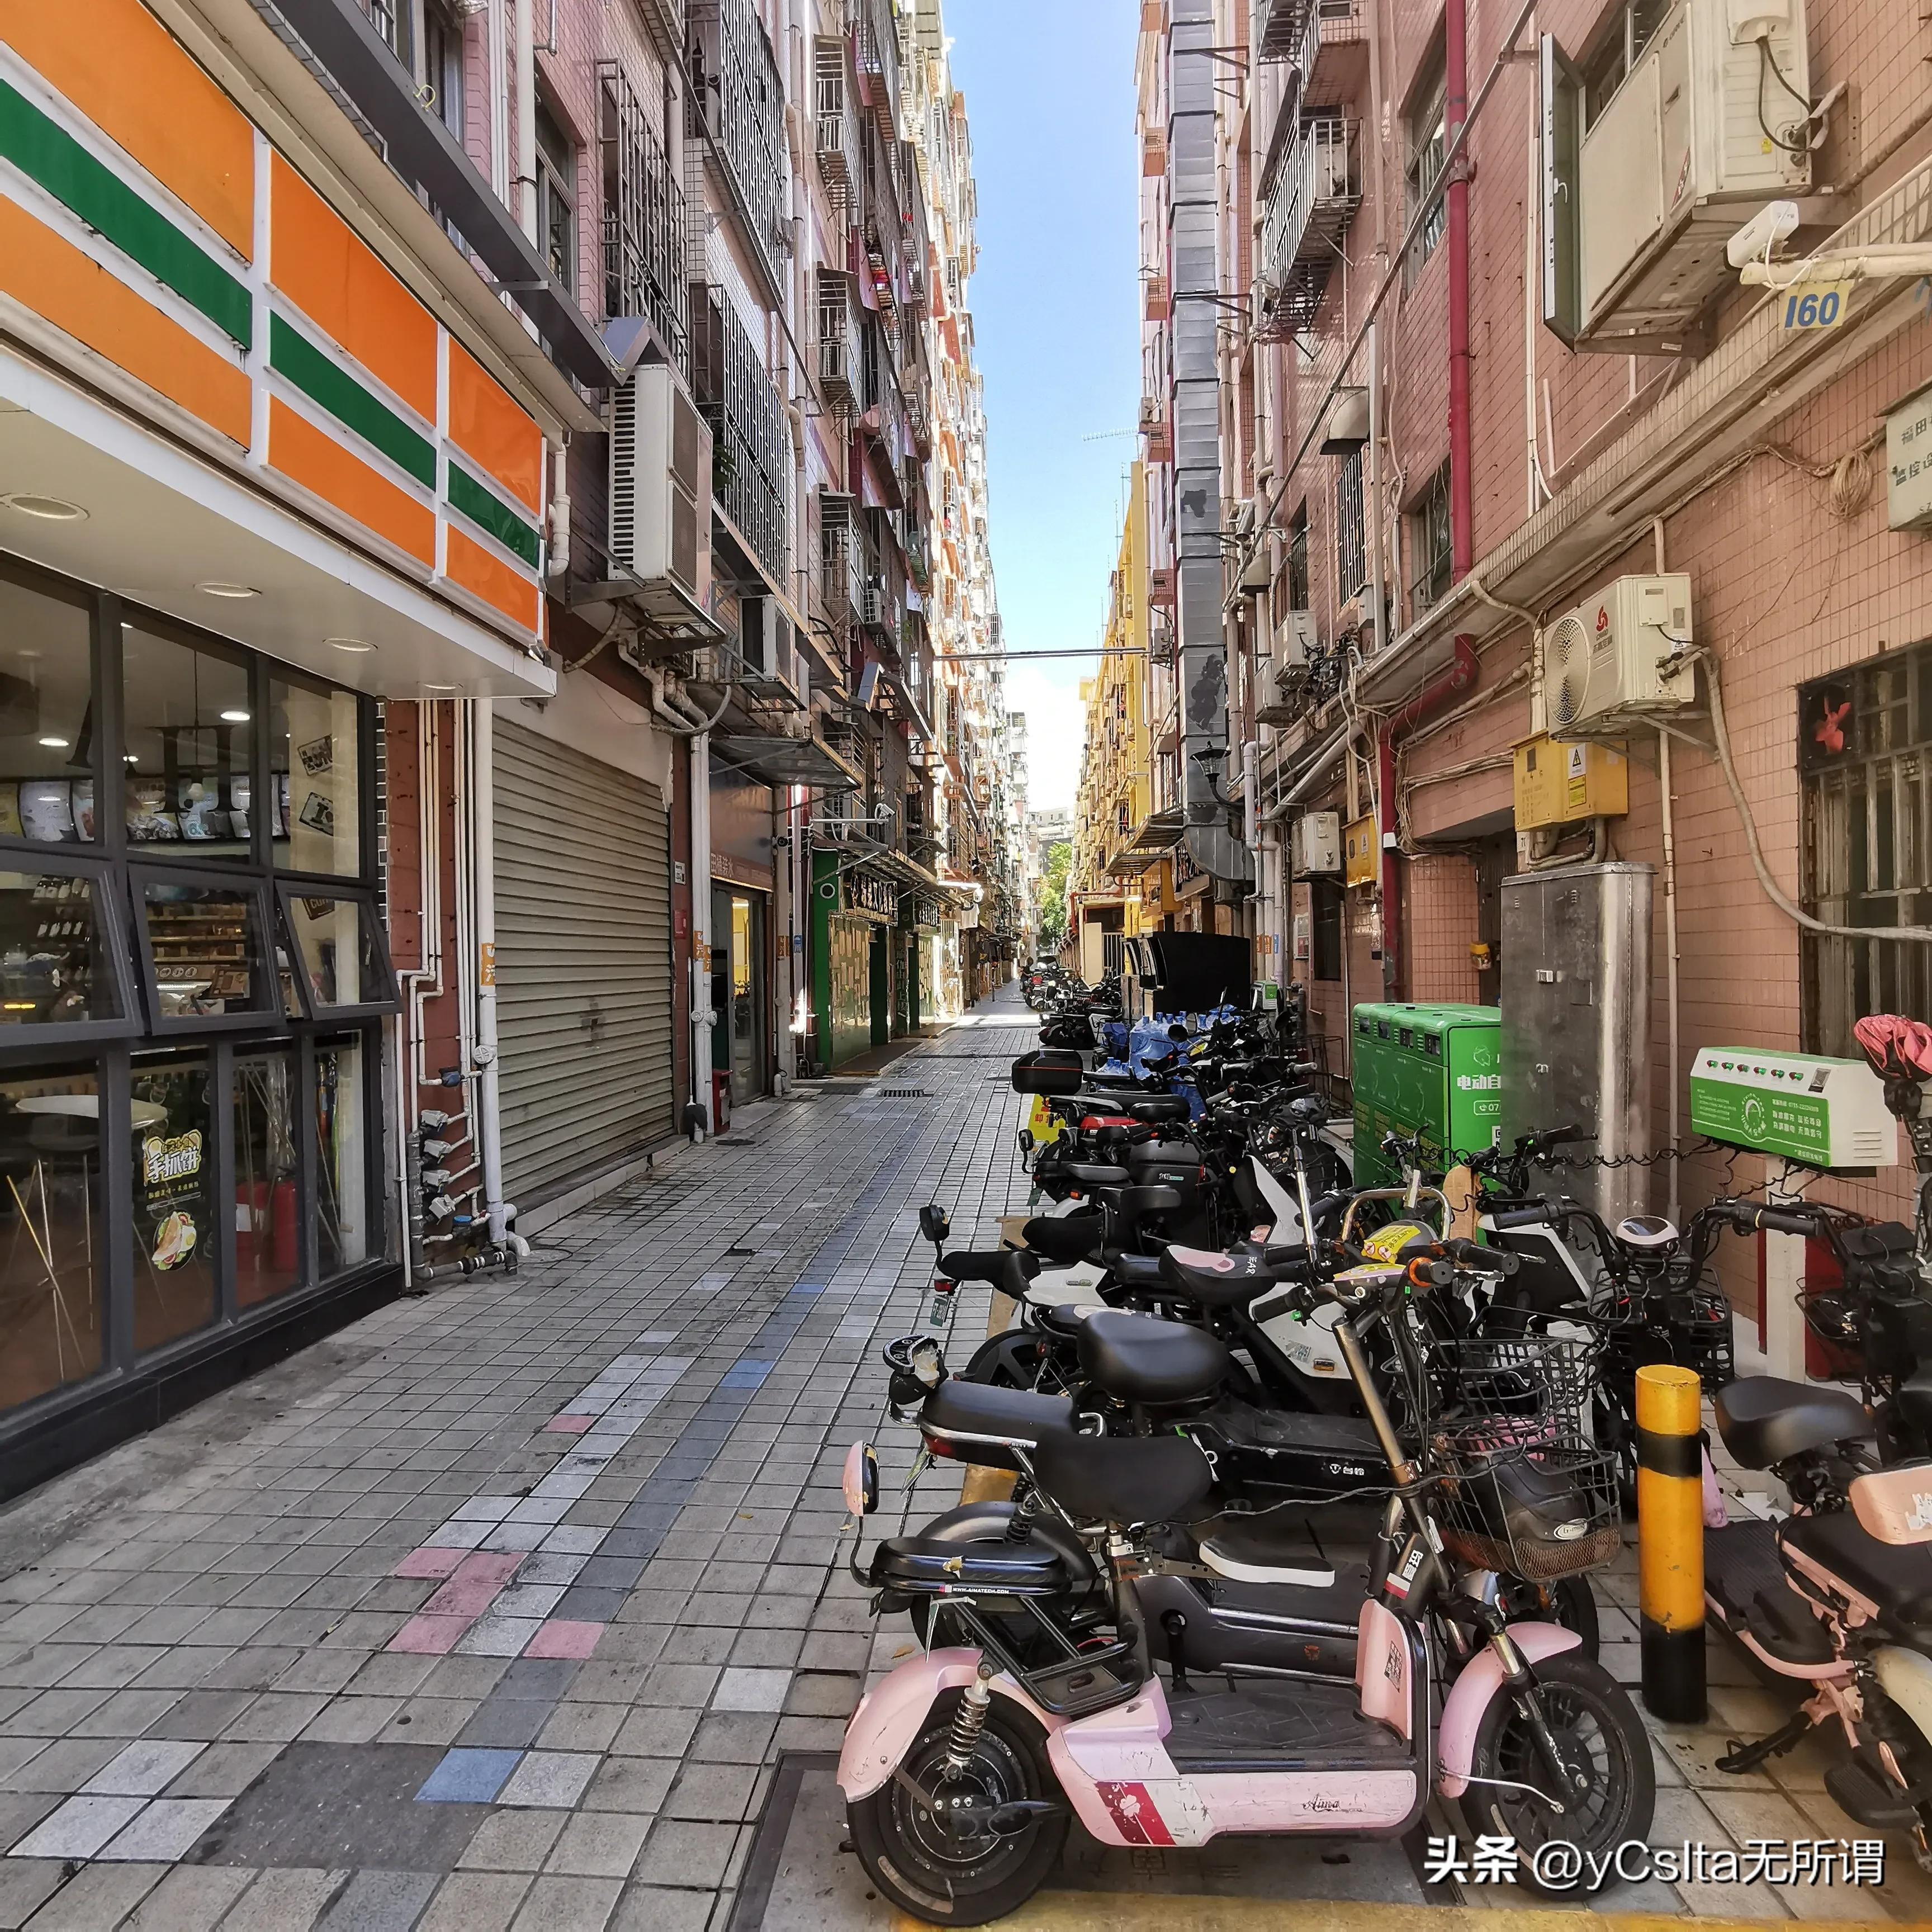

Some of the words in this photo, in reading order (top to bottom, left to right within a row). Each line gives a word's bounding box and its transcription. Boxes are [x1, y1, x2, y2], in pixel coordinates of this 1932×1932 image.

[1784, 292, 1840, 328] 160
[1901, 418, 1932, 444] 福田
[1457, 1074, 1502, 1090] 电动自
[148, 1146, 198, 1180] 手抓饼
